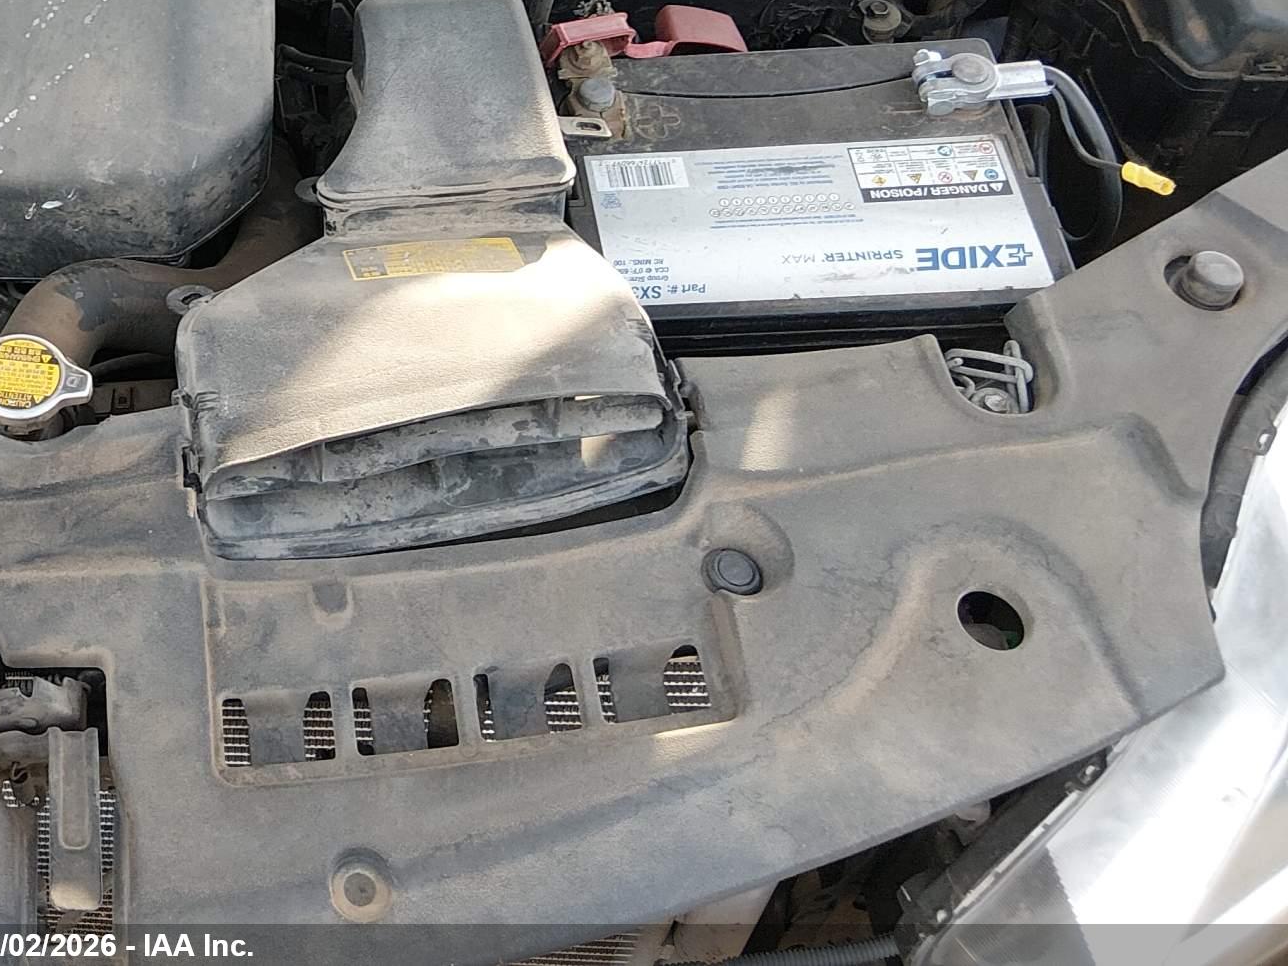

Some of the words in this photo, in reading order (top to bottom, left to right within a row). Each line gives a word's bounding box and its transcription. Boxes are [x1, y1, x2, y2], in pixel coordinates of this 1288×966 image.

[930, 183, 988, 196] DANGER
[782, 253, 815, 264] MAX
[825, 249, 904, 263] SPRINTER
[915, 244, 1033, 272] EXIDE
[647, 274, 669, 283] Group
[667, 285, 678, 294] #:
[682, 284, 706, 294] Part
